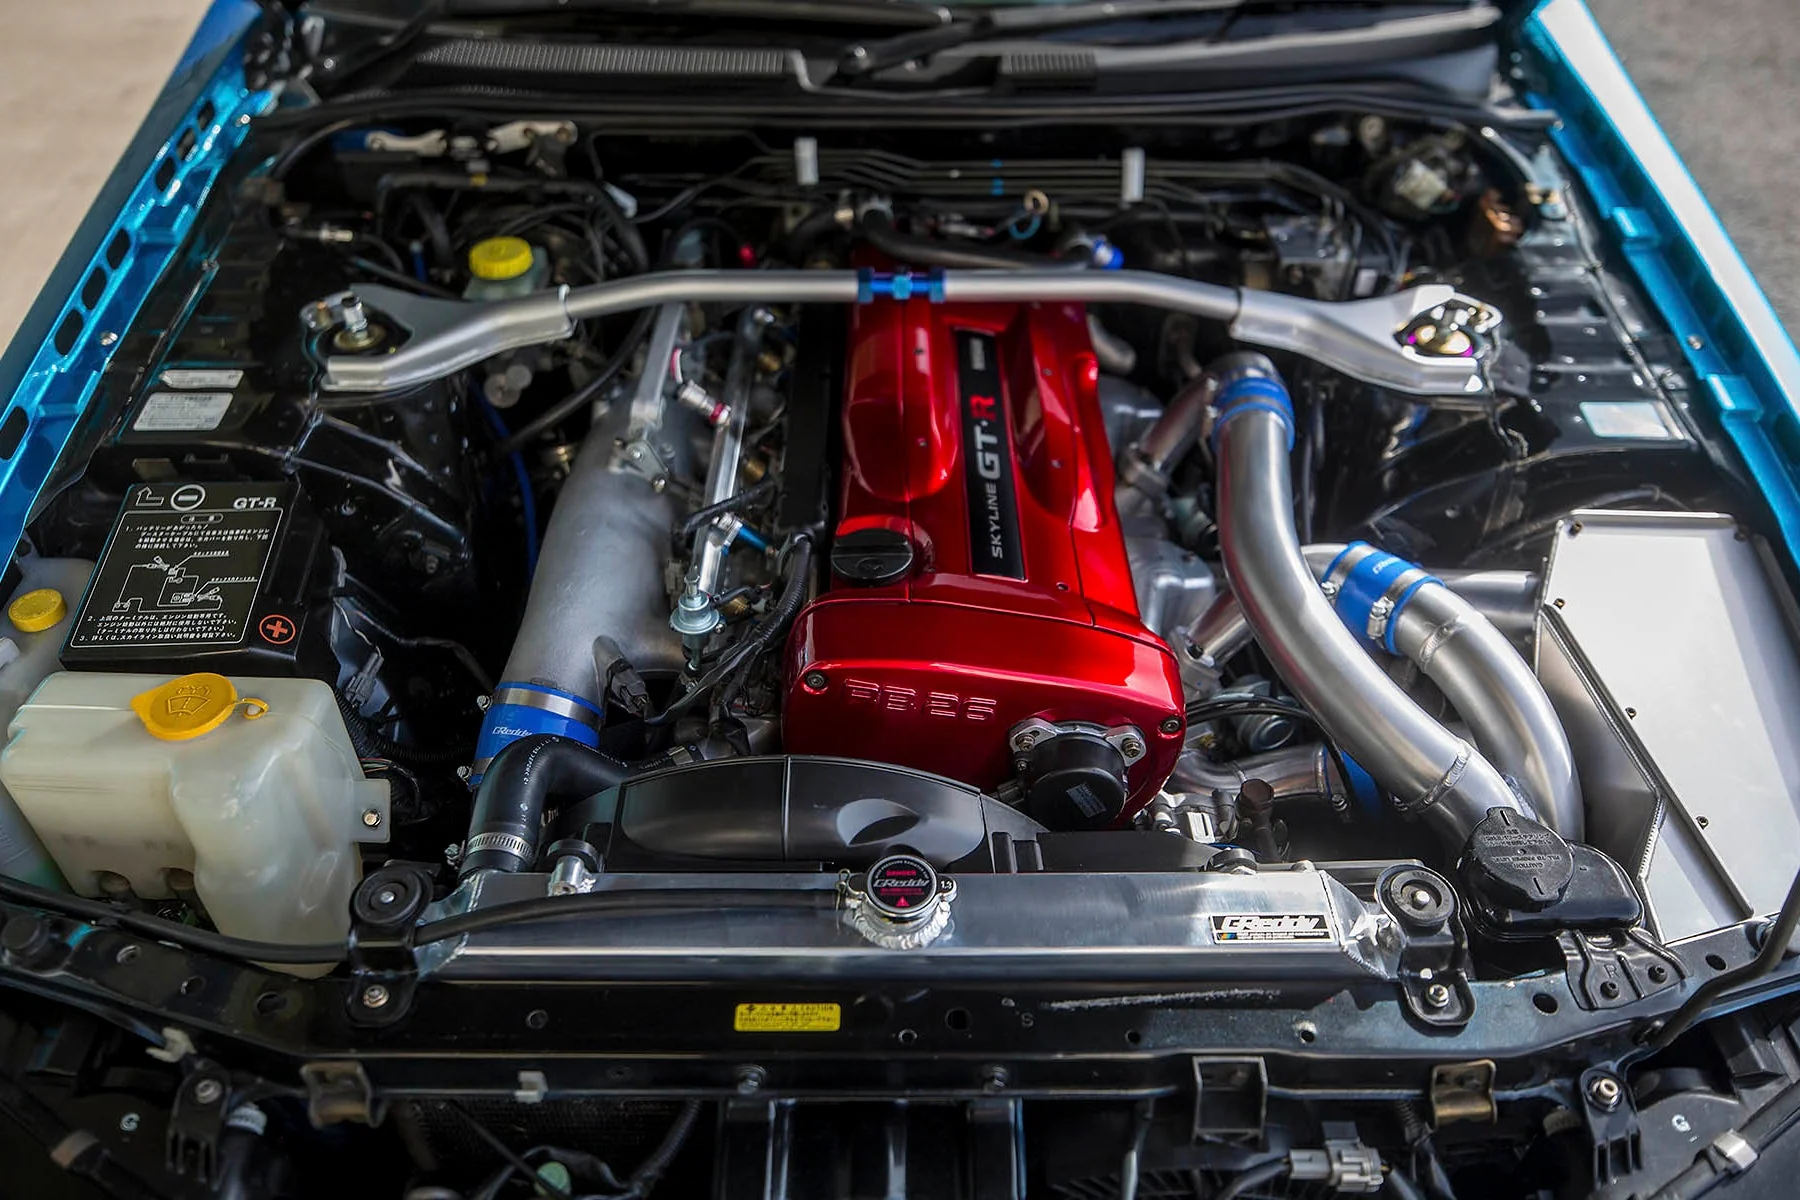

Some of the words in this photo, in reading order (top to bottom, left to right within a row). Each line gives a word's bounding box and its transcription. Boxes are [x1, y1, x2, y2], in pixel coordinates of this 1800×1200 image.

[233, 496, 277, 509] GT-R
[986, 482, 1003, 558] SKYLINE
[844, 678, 997, 721] RB26
[492, 726, 533, 737] GReddy
[873, 878, 930, 887] GReddy
[1221, 915, 1320, 930] GReddy
